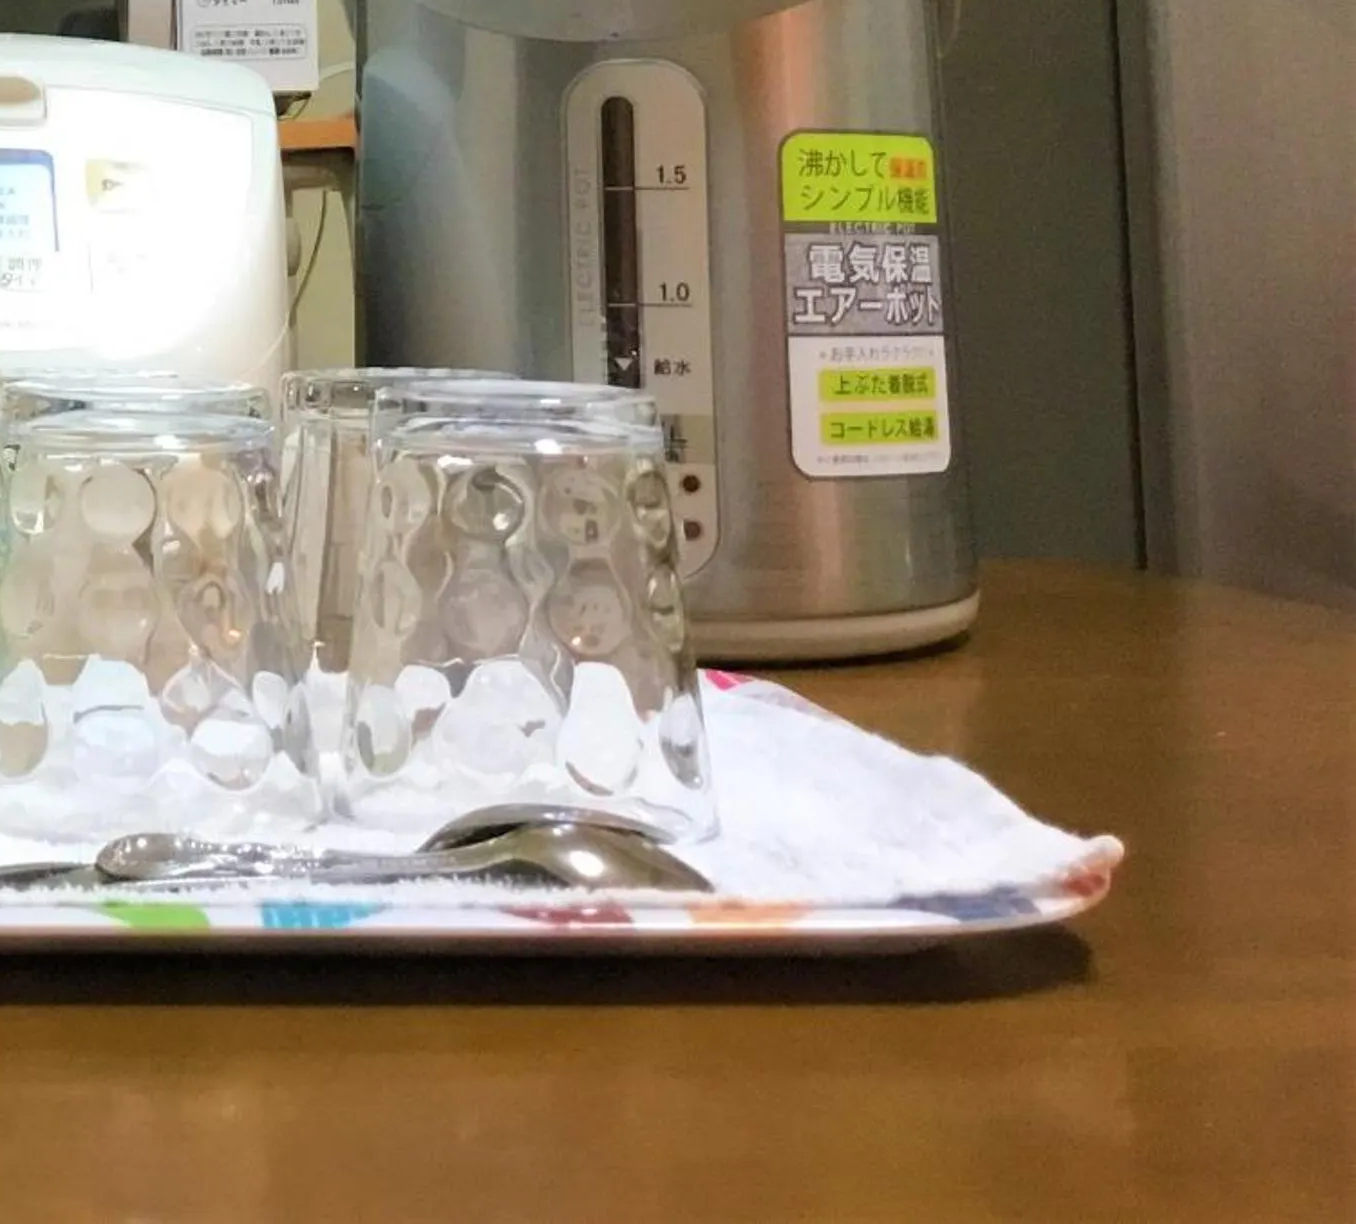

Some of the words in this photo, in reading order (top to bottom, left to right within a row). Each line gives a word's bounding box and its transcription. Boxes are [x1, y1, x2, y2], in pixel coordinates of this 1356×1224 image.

[656, 165, 688, 184] 1.5
[801, 183, 930, 216] シンプル機能
[808, 243, 932, 285] 電気保温
[659, 283, 690, 302] 1.0
[654, 359, 691, 376] 給水
